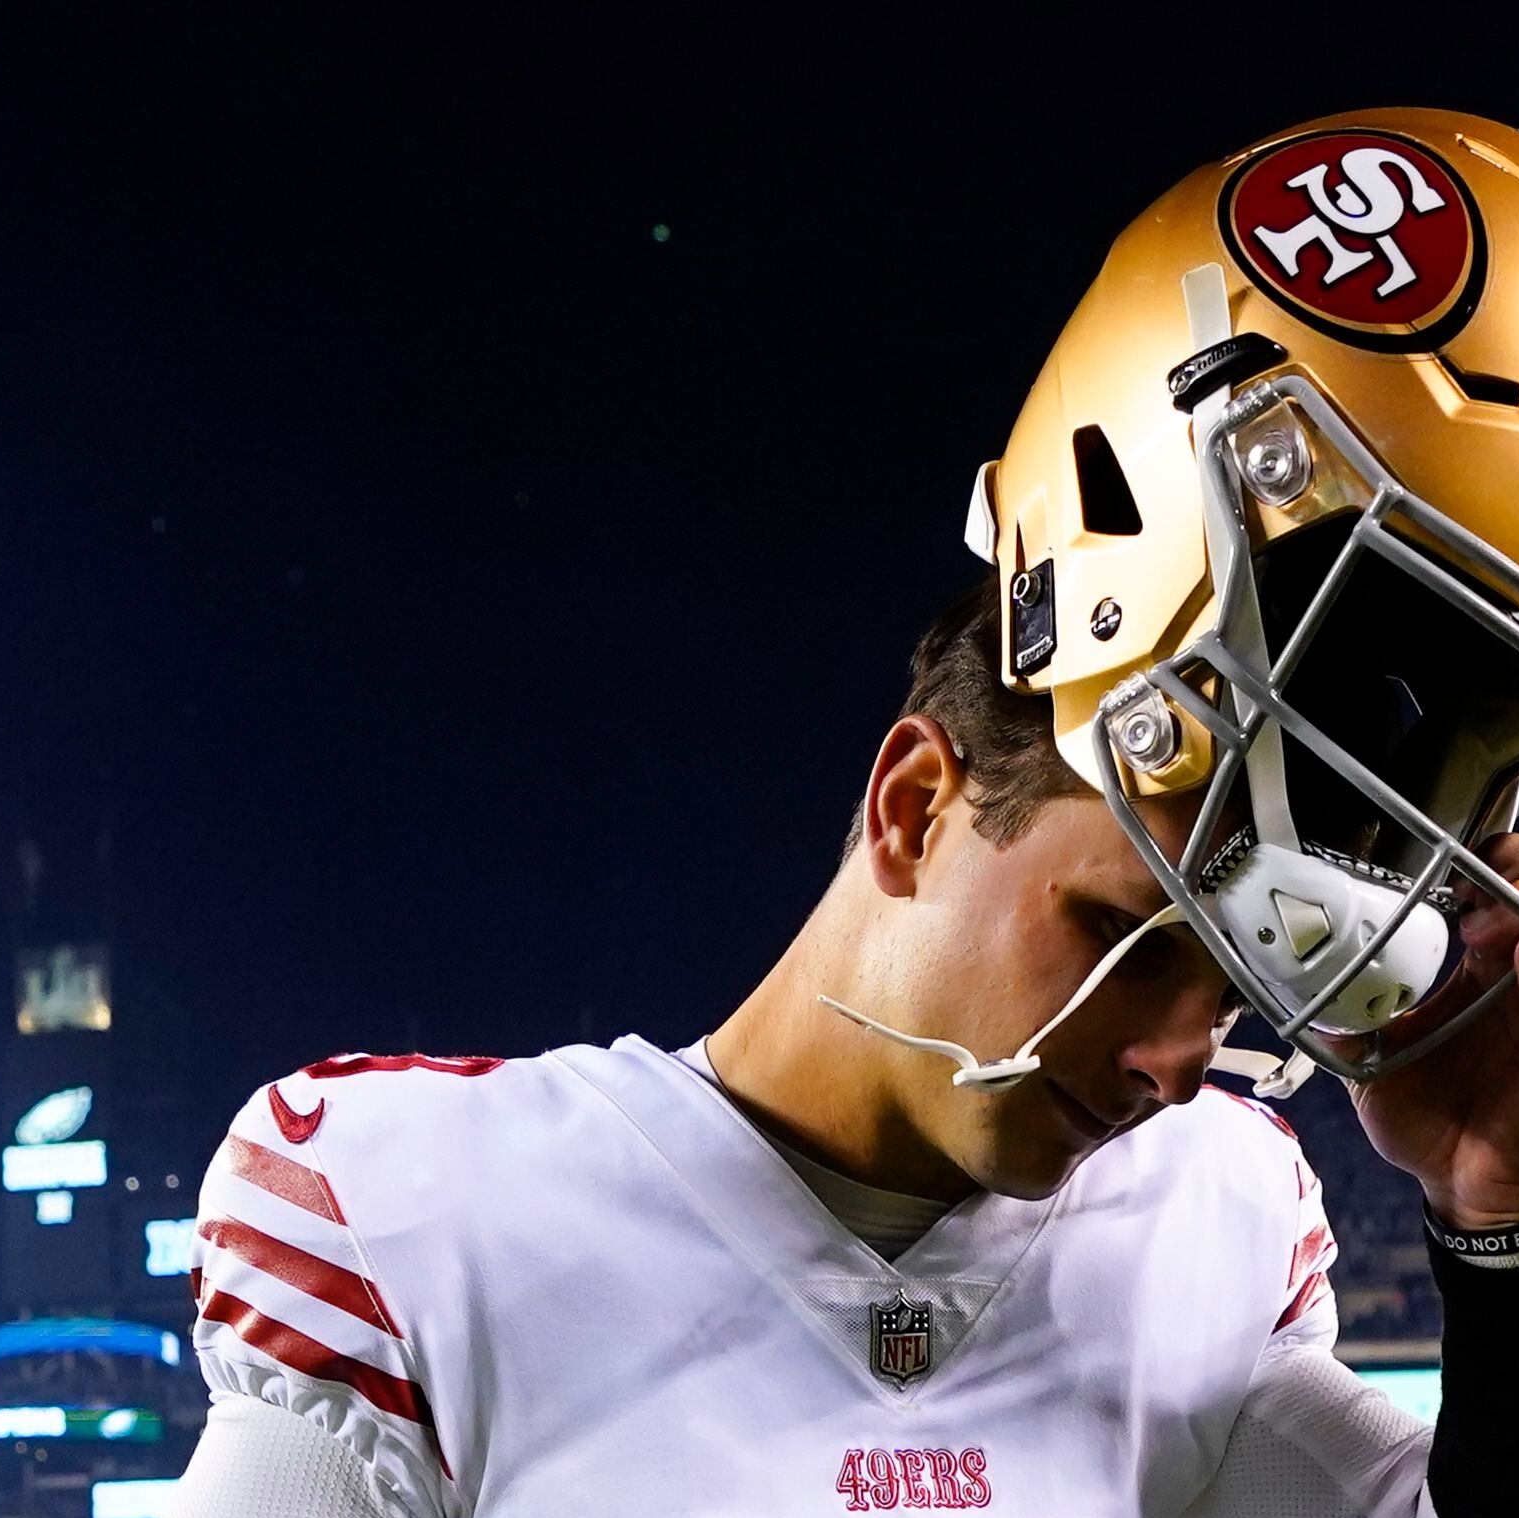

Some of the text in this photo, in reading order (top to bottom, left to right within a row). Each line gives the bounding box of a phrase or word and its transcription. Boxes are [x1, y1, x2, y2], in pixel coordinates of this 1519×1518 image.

[1253, 147, 1446, 298] SF
[1443, 1234, 1468, 1252] DO
[1471, 1235, 1508, 1253] NOT
[881, 1334, 928, 1378] NFL
[835, 1445, 993, 1512] 49ERS
